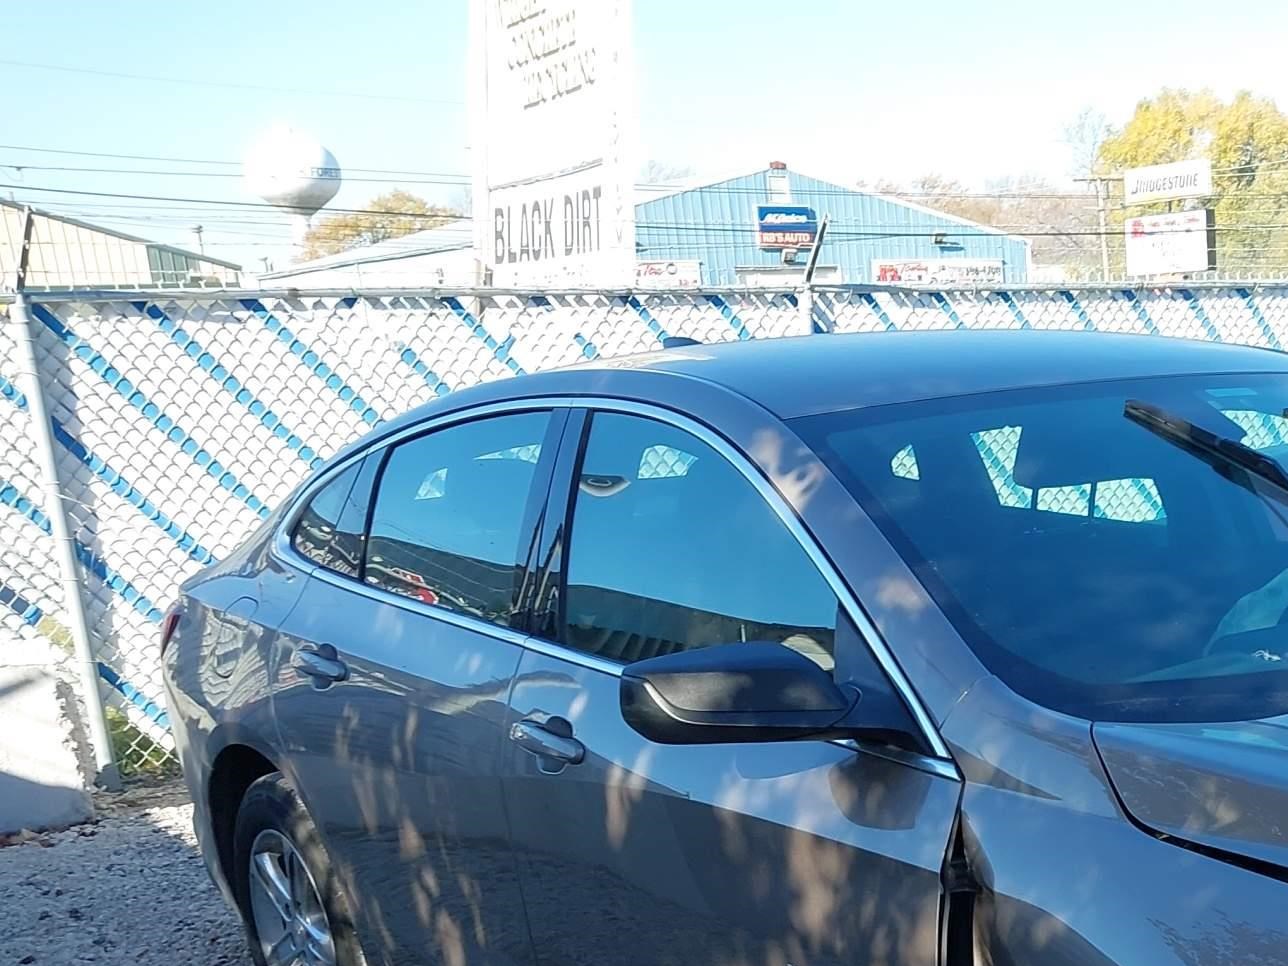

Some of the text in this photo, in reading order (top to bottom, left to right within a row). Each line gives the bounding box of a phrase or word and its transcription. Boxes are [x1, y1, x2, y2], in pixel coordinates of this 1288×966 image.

[494, 185, 603, 265] BLACK DIRT
[784, 232, 811, 243] AUTO
